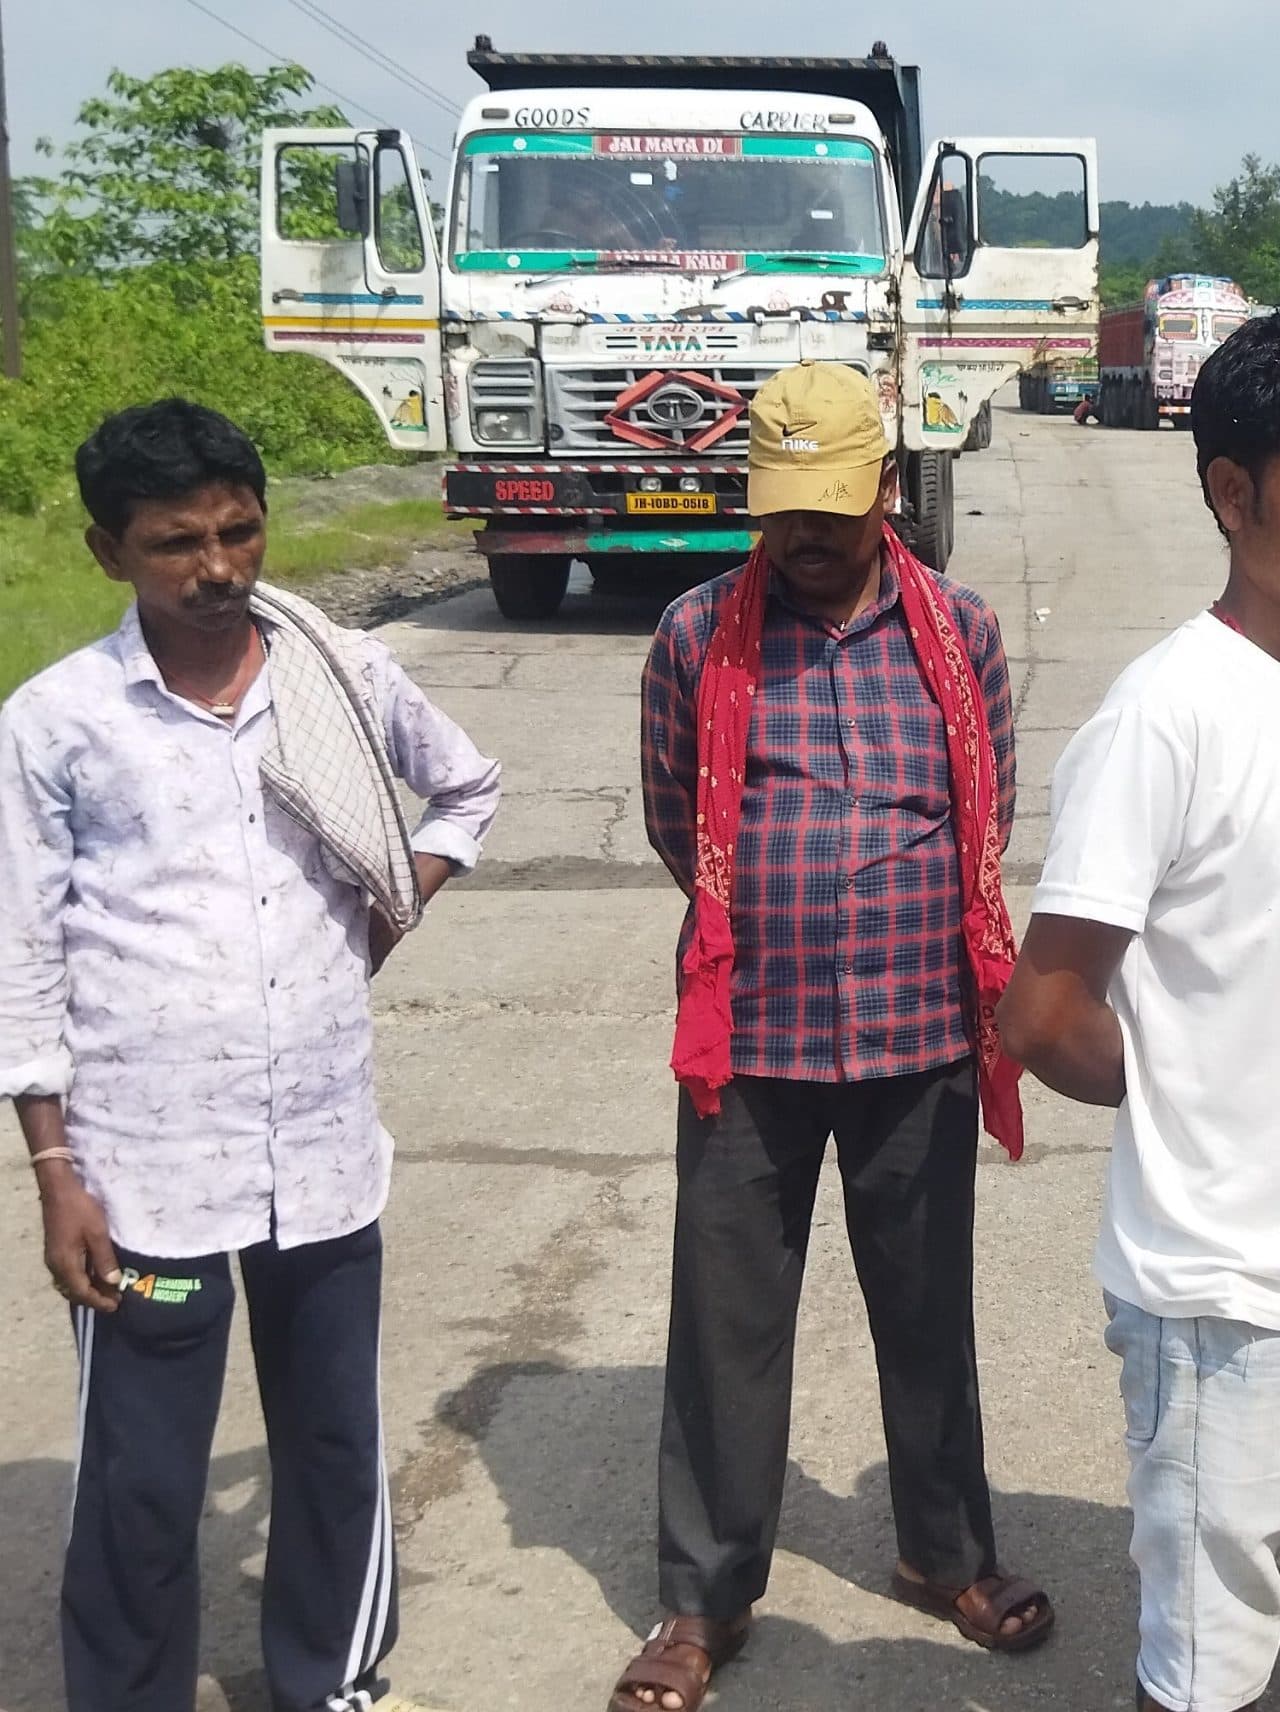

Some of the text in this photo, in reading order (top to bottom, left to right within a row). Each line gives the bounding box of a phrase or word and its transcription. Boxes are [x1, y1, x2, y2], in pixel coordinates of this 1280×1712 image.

[514, 107, 827, 133] GOODS CARRIER
[608, 136, 724, 153] JAI MATA DI
[640, 335, 702, 351] TATA
[782, 439, 820, 451] NIKE
[495, 480, 555, 501] SPEED
